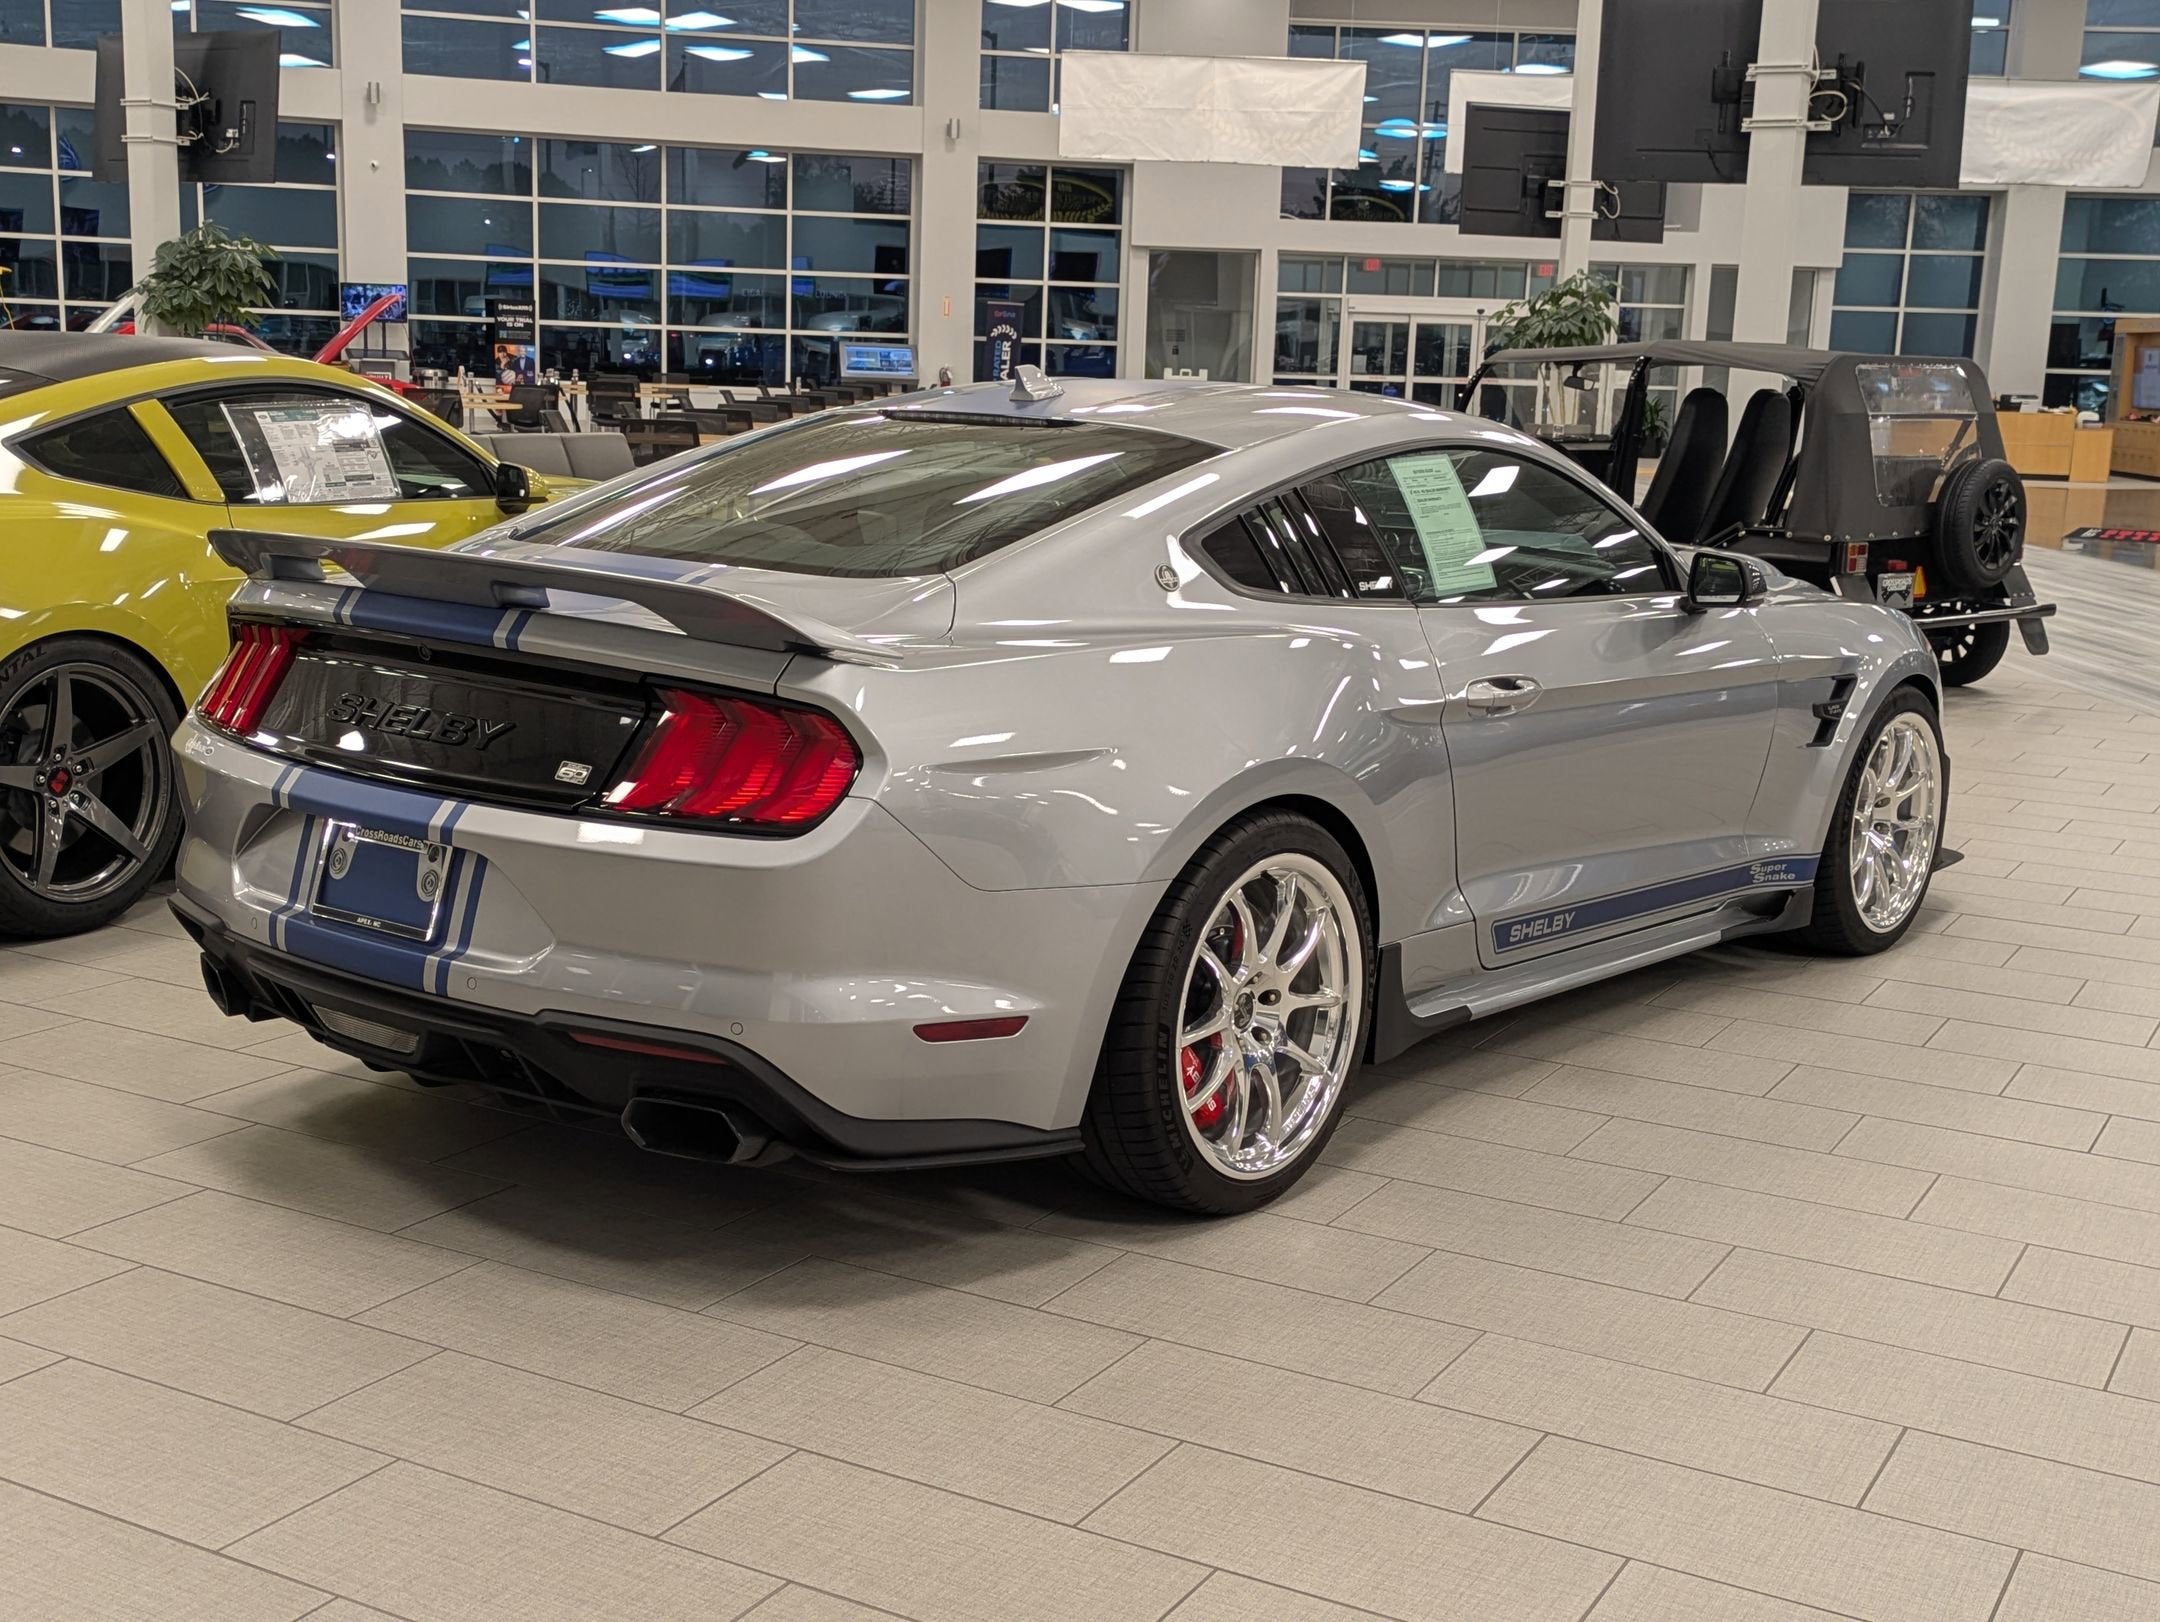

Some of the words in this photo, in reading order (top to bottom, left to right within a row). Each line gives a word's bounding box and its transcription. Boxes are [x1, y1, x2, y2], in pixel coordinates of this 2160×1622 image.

[993, 340, 1001, 377] RATED
[1001, 341, 1011, 380] ALER
[327, 692, 517, 751] SHELBY
[559, 767, 588, 779] 60
[1750, 864, 1787, 874] Super
[1752, 872, 1796, 883] Snake
[1509, 911, 1576, 943] SHELBY
[1158, 1031, 1182, 1149] MICHELIN
